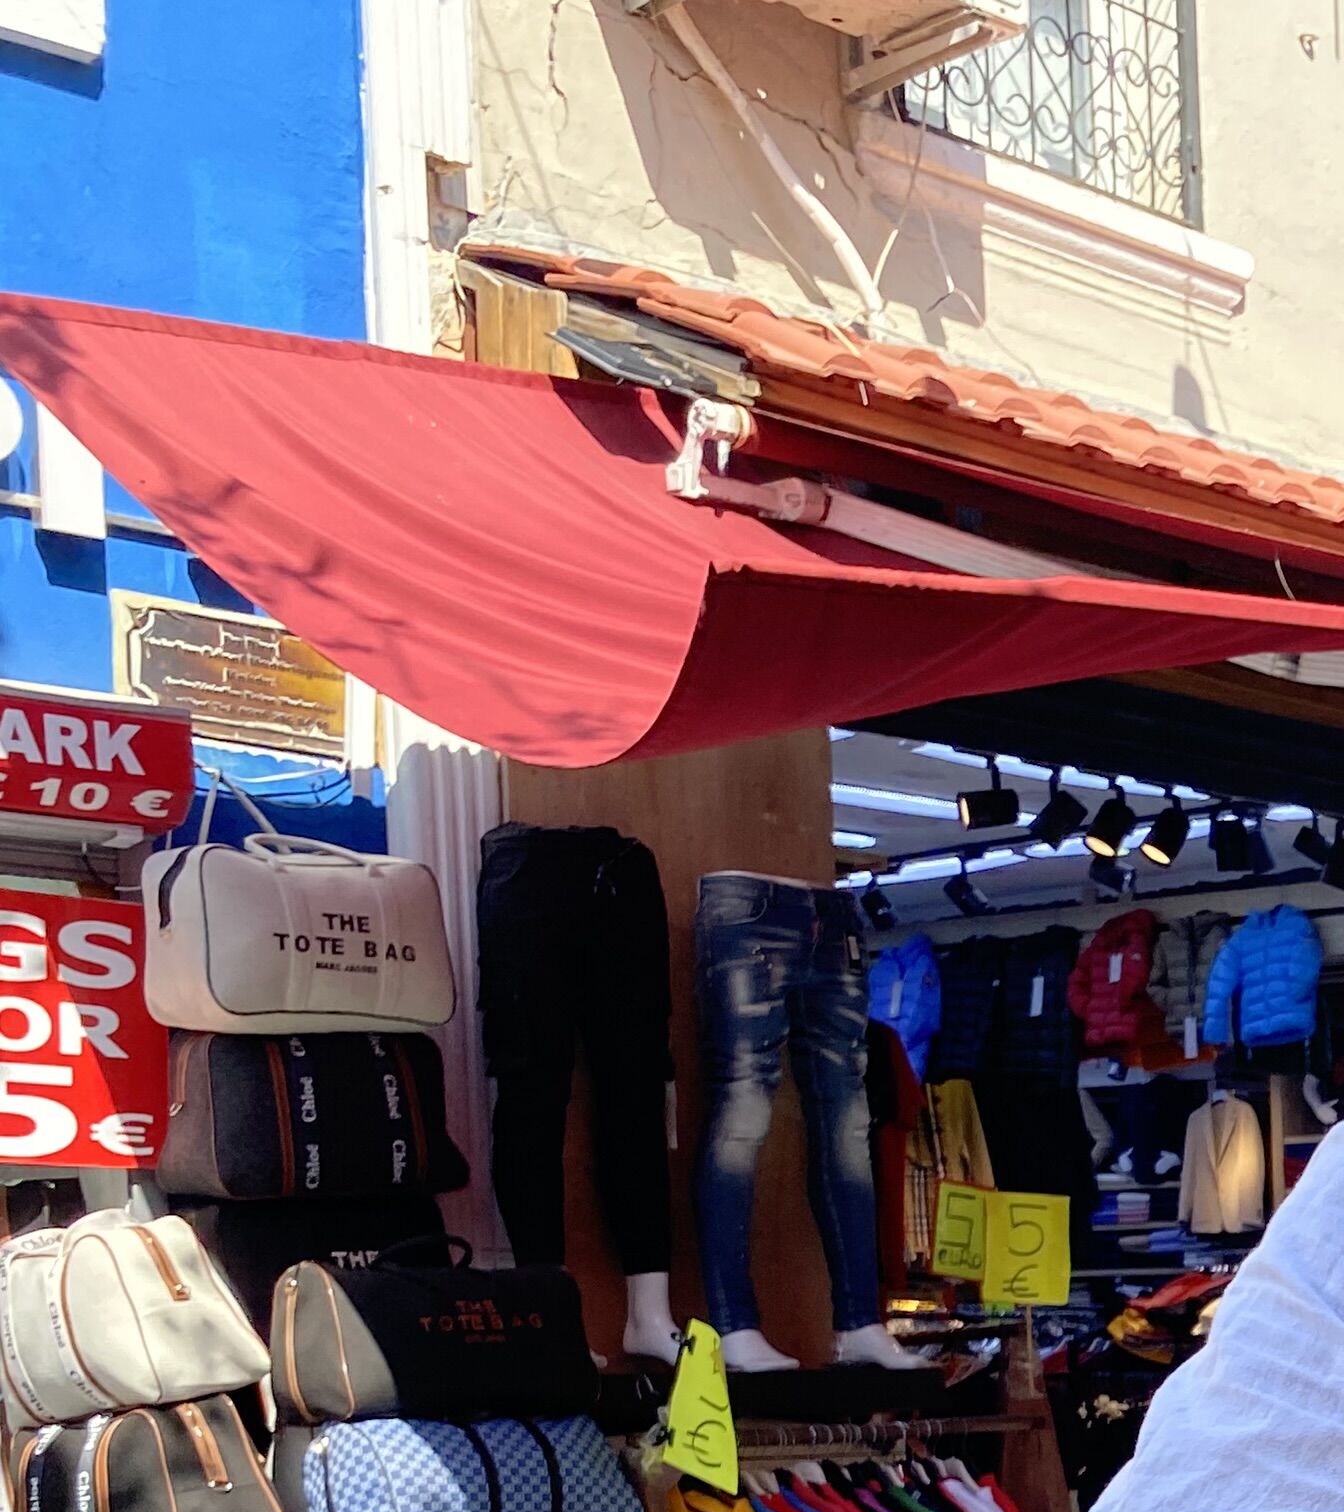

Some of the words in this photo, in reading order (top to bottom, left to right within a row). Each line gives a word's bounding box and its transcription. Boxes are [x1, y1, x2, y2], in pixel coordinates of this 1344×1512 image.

[0, 708, 146, 776] ARK
[30, 777, 110, 811] 10
[130, 789, 174, 818] €
[0, 910, 136, 990] GS
[273, 933, 345, 955] TOTE
[364, 940, 416, 962] BAG
[322, 913, 371, 933] THE
[0, 996, 129, 1060] OR
[0, 1061, 79, 1159] 5
[90, 1112, 155, 1157] €
[940, 1191, 976, 1248] 5
[1008, 1203, 1048, 1257] 5
[1003, 1263, 1040, 1298] €
[682, 1419, 728, 1468] €
